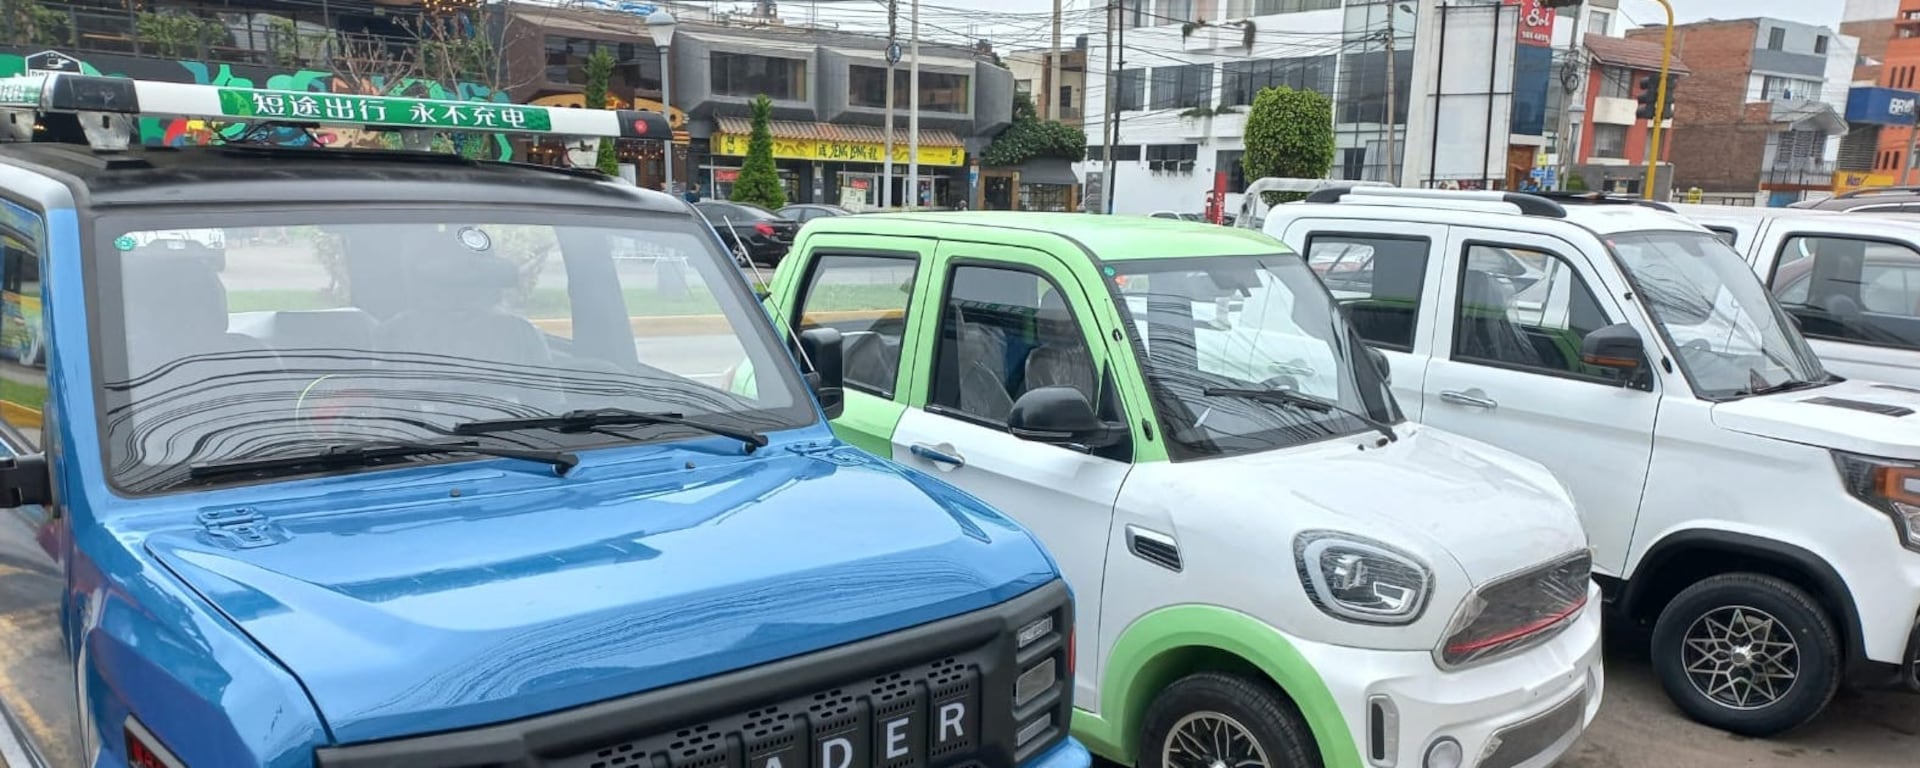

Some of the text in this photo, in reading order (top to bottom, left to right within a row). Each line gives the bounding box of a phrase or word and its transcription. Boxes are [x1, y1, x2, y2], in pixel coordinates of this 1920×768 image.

[252, 91, 527, 129] 短途出行 永不充电
[764, 702, 965, 768] DER
